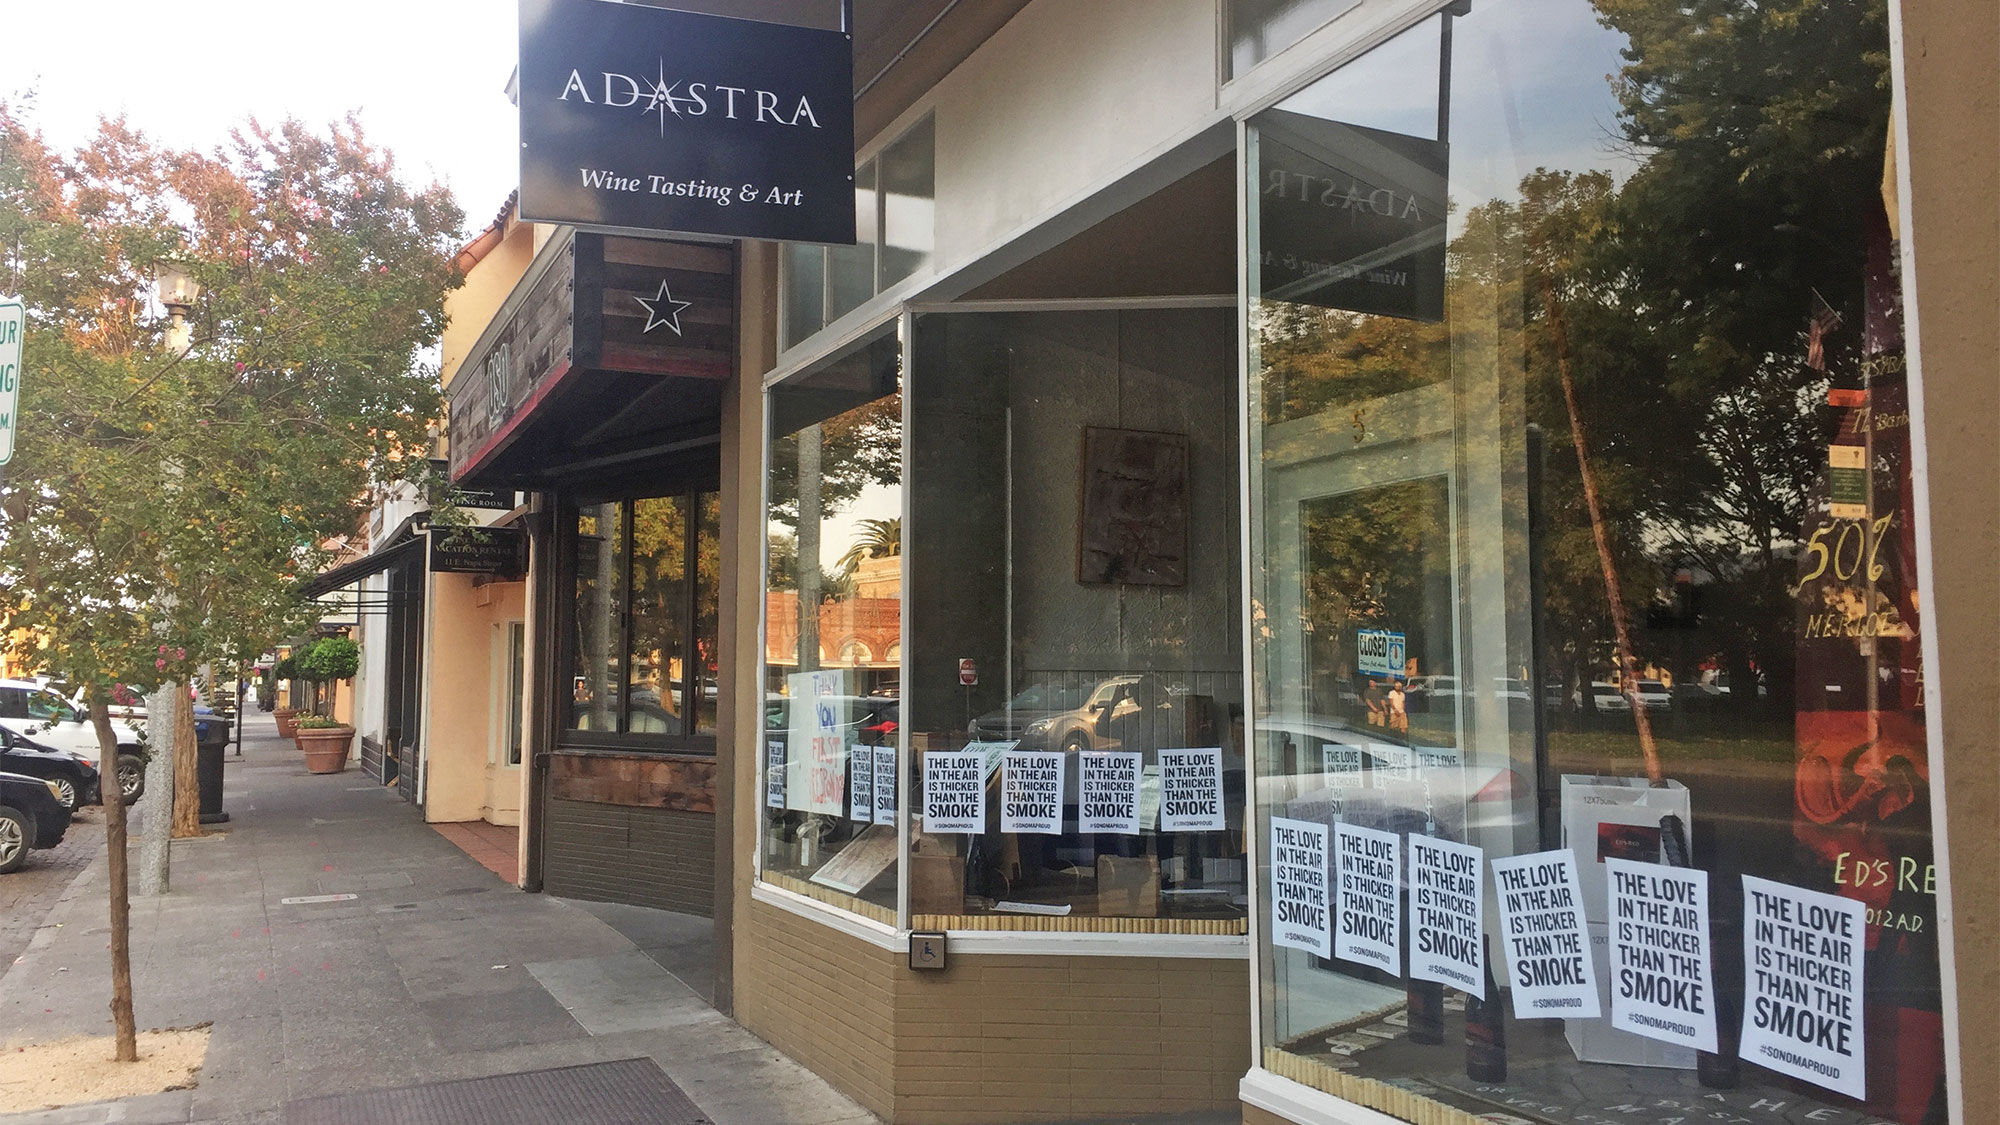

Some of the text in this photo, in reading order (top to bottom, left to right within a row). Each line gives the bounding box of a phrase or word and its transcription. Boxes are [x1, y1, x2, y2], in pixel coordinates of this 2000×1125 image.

[556, 67, 822, 129] ADASTRA
[580, 168, 803, 206] Wine Tasting & Art
[1360, 635, 1387, 657] CLOSED
[816, 703, 836, 733] YOU
[928, 758, 978, 769] THE LOVE
[1006, 757, 1058, 769] THE LOVE
[1083, 757, 1135, 769] THE LOVE
[1162, 754, 1215, 766] THE LOVE
[1326, 751, 1358, 763] THE LOVE
[929, 770, 978, 780] IN THE AIR
[1008, 770, 1057, 780] IN THE AIR
[1084, 770, 1134, 780] IN THE AIR
[1164, 766, 1215, 778] IN THE AIR
[1165, 778, 1216, 789] IS THICKER
[928, 792, 979, 803] THAN THE
[929, 782, 978, 791] IS THICKER
[1006, 792, 1056, 803] THAN THE
[1007, 781, 1057, 792] IS THICKER
[1084, 781, 1134, 792] IS THICKER
[1084, 792, 1134, 803] THAN THE
[1164, 789, 1216, 800] THAN THE
[929, 804, 978, 818] SMOKE
[1006, 803, 1056, 818] SMOKE
[1084, 803, 1134, 818] SMOKE
[1166, 800, 1217, 816] SMOKE
[1276, 827, 1322, 850] THE LOVE
[1340, 834, 1393, 862] THE LOVE
[1277, 847, 1322, 869] IN THE AIR
[1342, 854, 1393, 881] IN THE AIR
[1415, 845, 1475, 876] THE LOVE
[1834, 852, 1889, 887] ED'S
[1277, 865, 1323, 887] IS THICKER
[1343, 874, 1394, 900] IS THICKER
[1418, 868, 1475, 898] IN THE AIR
[1499, 862, 1568, 890] THE LOVE
[1277, 882, 1324, 906] THAN THE
[1506, 888, 1573, 912] IN THE AIR
[1613, 871, 1697, 906] THE LOVE
[1343, 891, 1394, 920] THAN THE
[1418, 888, 1476, 918] IS THICKER
[1618, 897, 1699, 931] IN THE AIR
[1751, 891, 1852, 938] THE LOVE
[1278, 900, 1324, 931] SMOKE
[1417, 907, 1477, 940] THAN THE
[1510, 911, 1577, 934] IS THICKER
[1865, 908, 1923, 933] 012 A.D.
[1284, 932, 1321, 948] #SONOMAPROUD
[1343, 911, 1394, 947] SMOKE
[1619, 922, 1700, 955] IS THICKER
[1419, 928, 1478, 968] SMOKE
[1512, 936, 1552, 957] THAN
[1553, 933, 1582, 954] THE
[1755, 919, 1851, 966] IN THE AIR
[1349, 945, 1391, 965] #SONOMAPROUD
[1618, 944, 1702, 982] THAN THE
[1428, 963, 1476, 986] #SONOMAPROUD
[1517, 957, 1586, 987] SMOKE
[1756, 945, 1851, 992] IS THICKER
[1532, 998, 1582, 1008] #SONOMAPROUD
[1620, 968, 1704, 1014] SMOKE
[1755, 969, 1852, 1021] THAN THE
[1628, 1013, 1696, 1037] #SONOMAPROUD
[1754, 996, 1852, 1057] SMOKE
[1760, 1044, 1840, 1079] #SONOMAPROUD
